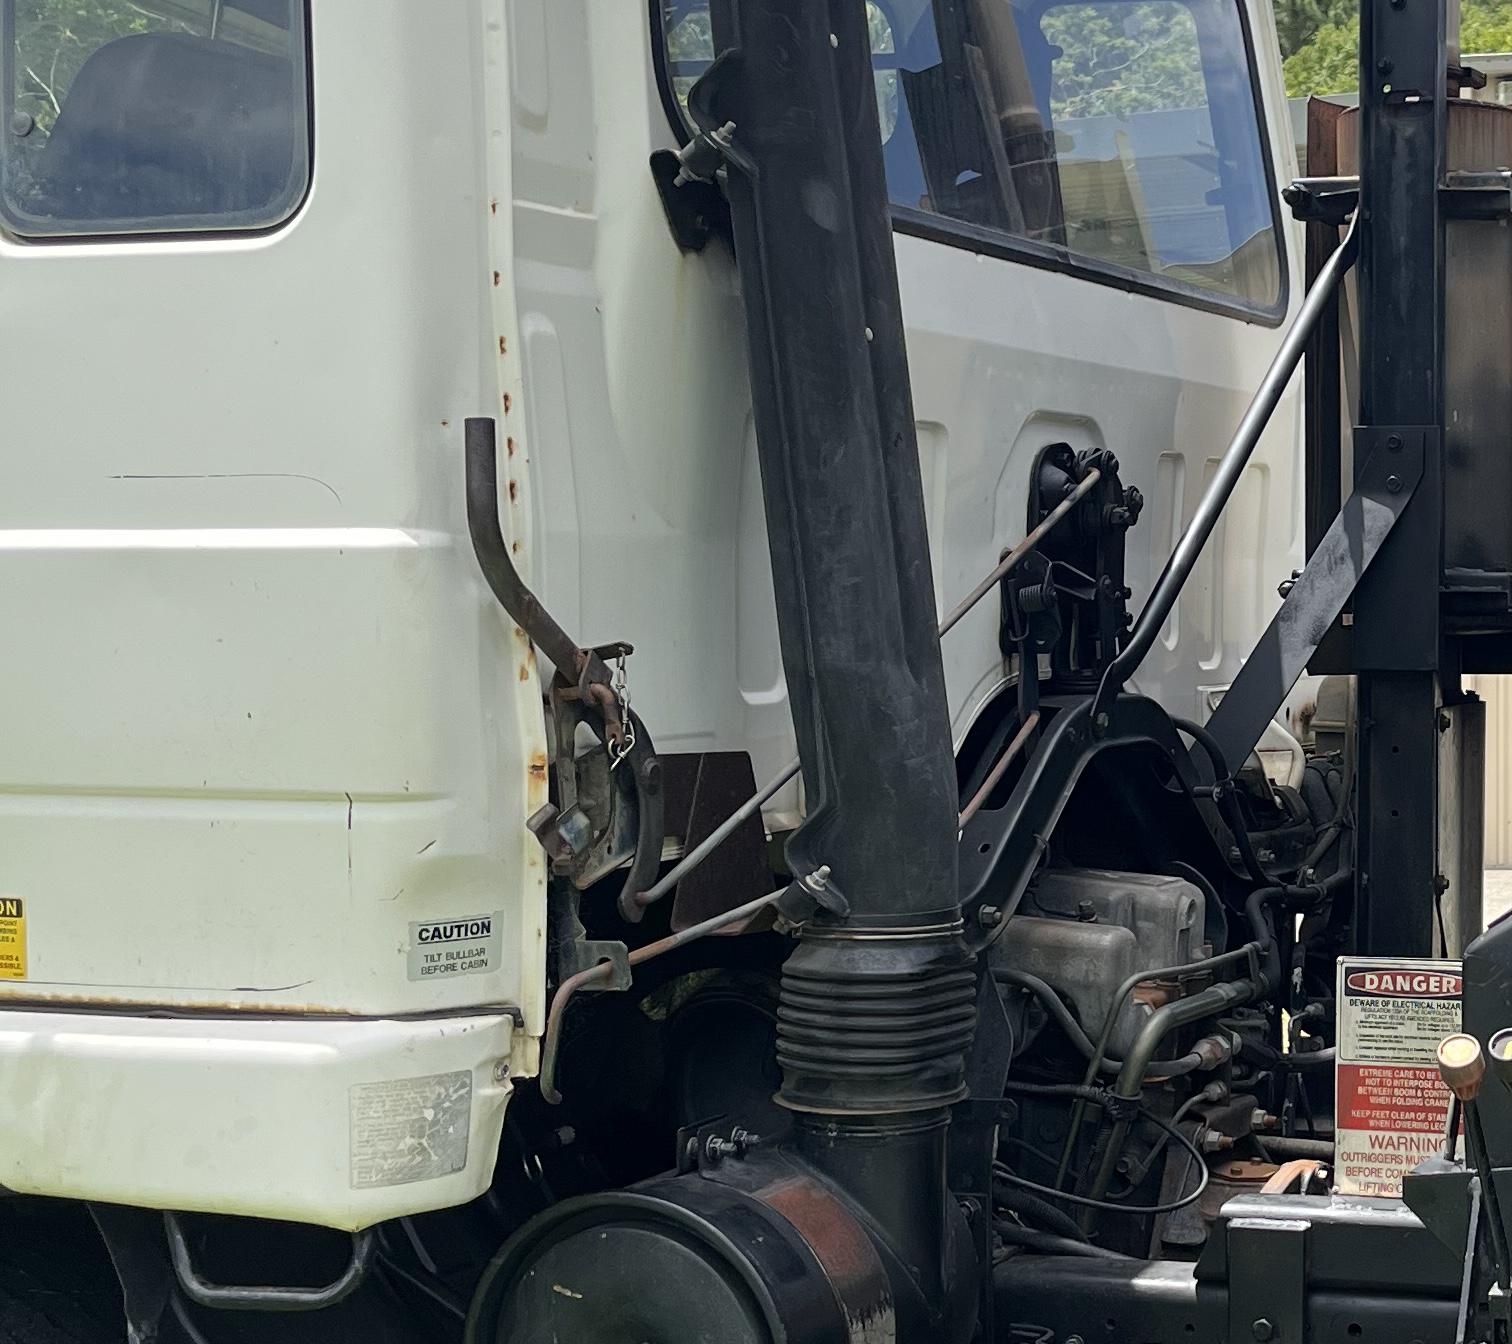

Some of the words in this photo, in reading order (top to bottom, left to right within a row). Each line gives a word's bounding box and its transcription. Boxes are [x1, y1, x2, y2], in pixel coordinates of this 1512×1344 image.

[418, 920, 491, 941] CAUTION
[424, 953, 442, 963] TILT
[445, 947, 486, 961] BULLBAR
[421, 963, 457, 975] BEFORE
[461, 959, 488, 971] CABIN
[1364, 973, 1456, 993] DANGER
[1349, 999, 1379, 1007] BEWARE
[1381, 1000, 1390, 1008] OF
[1392, 1001, 1434, 1009] ELECTRICAL
[1436, 1002, 1461, 1010] HAZAR
[1360, 1068, 1392, 1077] EXTREME
[1394, 1070, 1414, 1078] CARE
[1415, 1071, 1424, 1079] TO
[1427, 1071, 1436, 1079] BE
[1365, 1078, 1382, 1086] NOT
[1383, 1078, 1391, 1086] TO
[1393, 1079, 1433, 1088] INTERPOSE
[1358, 1086, 1393, 1095] BETWEEN
[1394, 1087, 1416, 1096] BOOM
[1417, 1088, 1421, 1096] &
[1370, 1096, 1391, 1104] WHEN
[1392, 1097, 1423, 1106] FOLDING
[1425, 1098, 1449, 1107] CRANE
[1352, 1109, 1371, 1117] KEEP
[1372, 1110, 1389, 1118] FEET
[1391, 1111, 1414, 1120] CLEAR
[1416, 1112, 1425, 1120] OF
[1369, 1119, 1390, 1127] WHEN
[1391, 1120, 1429, 1129] LOWERING
[1341, 1151, 1404, 1164] OUTRIGGERS
[1345, 1166, 1383, 1177] BEFORE
[1359, 1182, 1393, 1193] LIFTING
